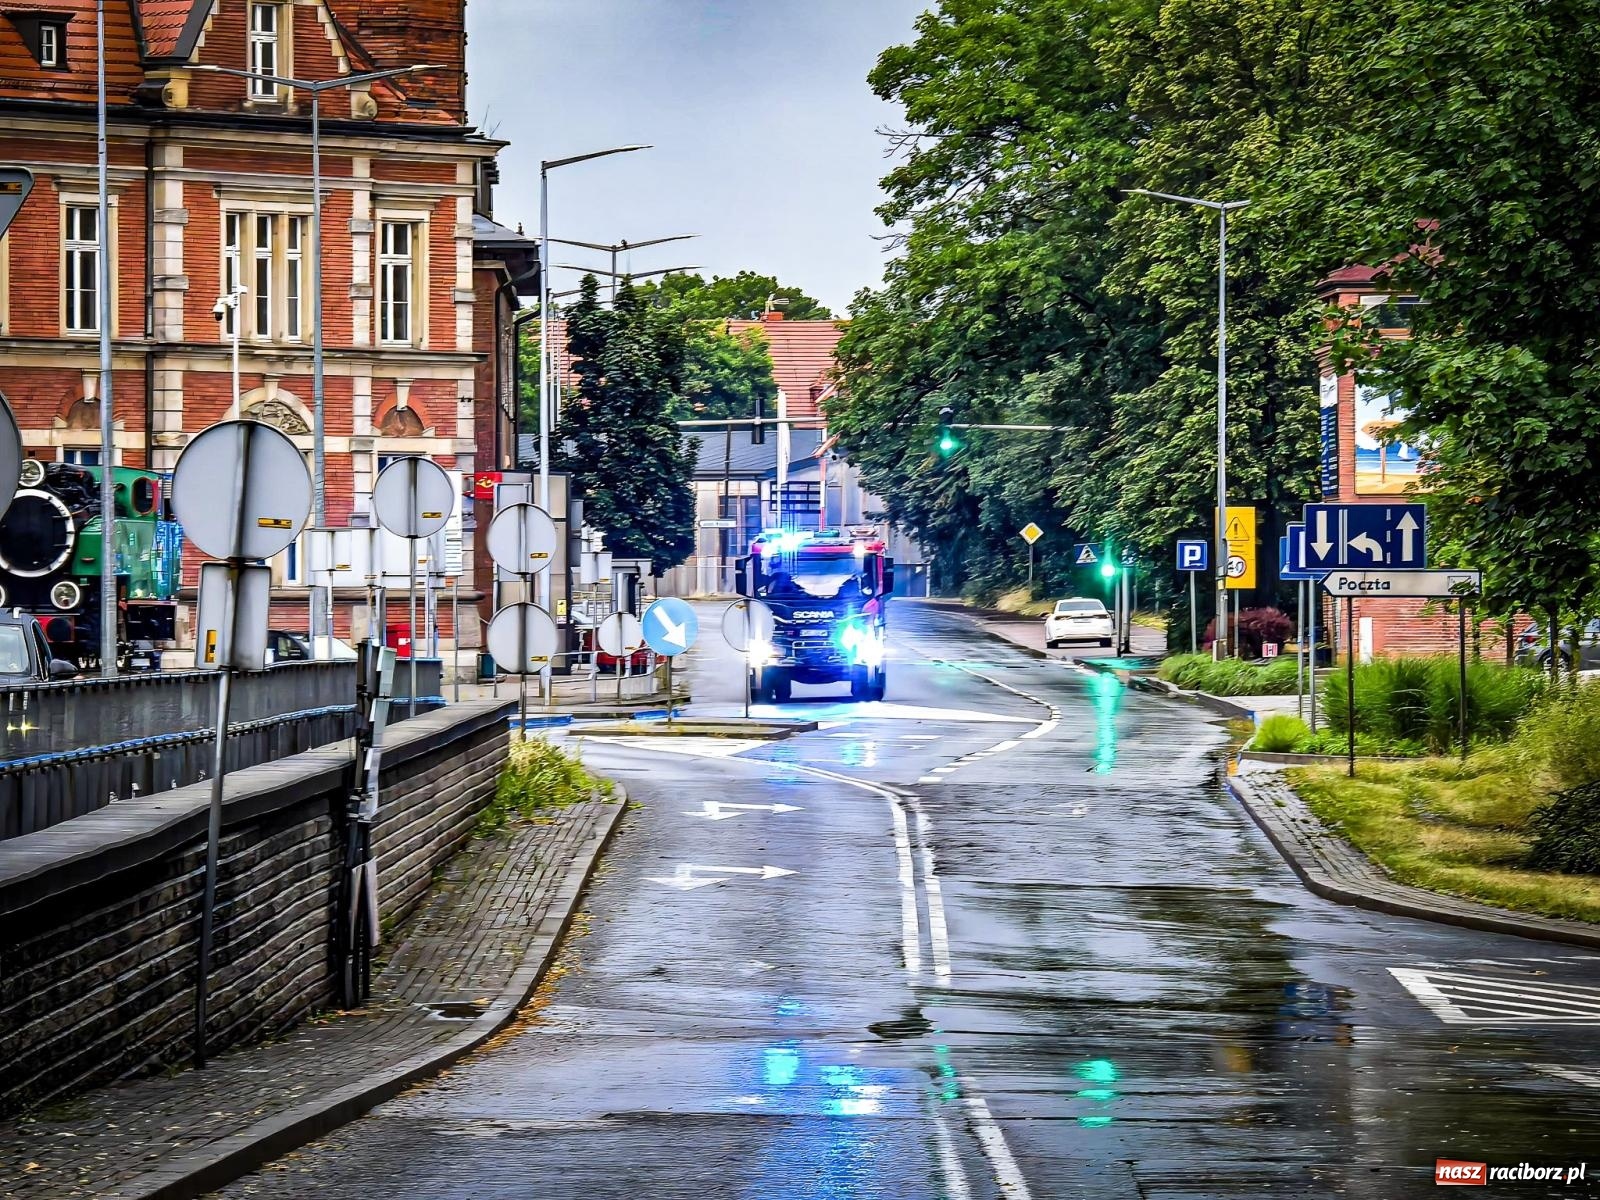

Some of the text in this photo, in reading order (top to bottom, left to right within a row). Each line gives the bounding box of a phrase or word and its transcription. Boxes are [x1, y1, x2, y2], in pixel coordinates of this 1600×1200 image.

[1183, 545, 1202, 567] P
[1338, 576, 1391, 591] Poczta
[792, 610, 835, 619] SCANIA
